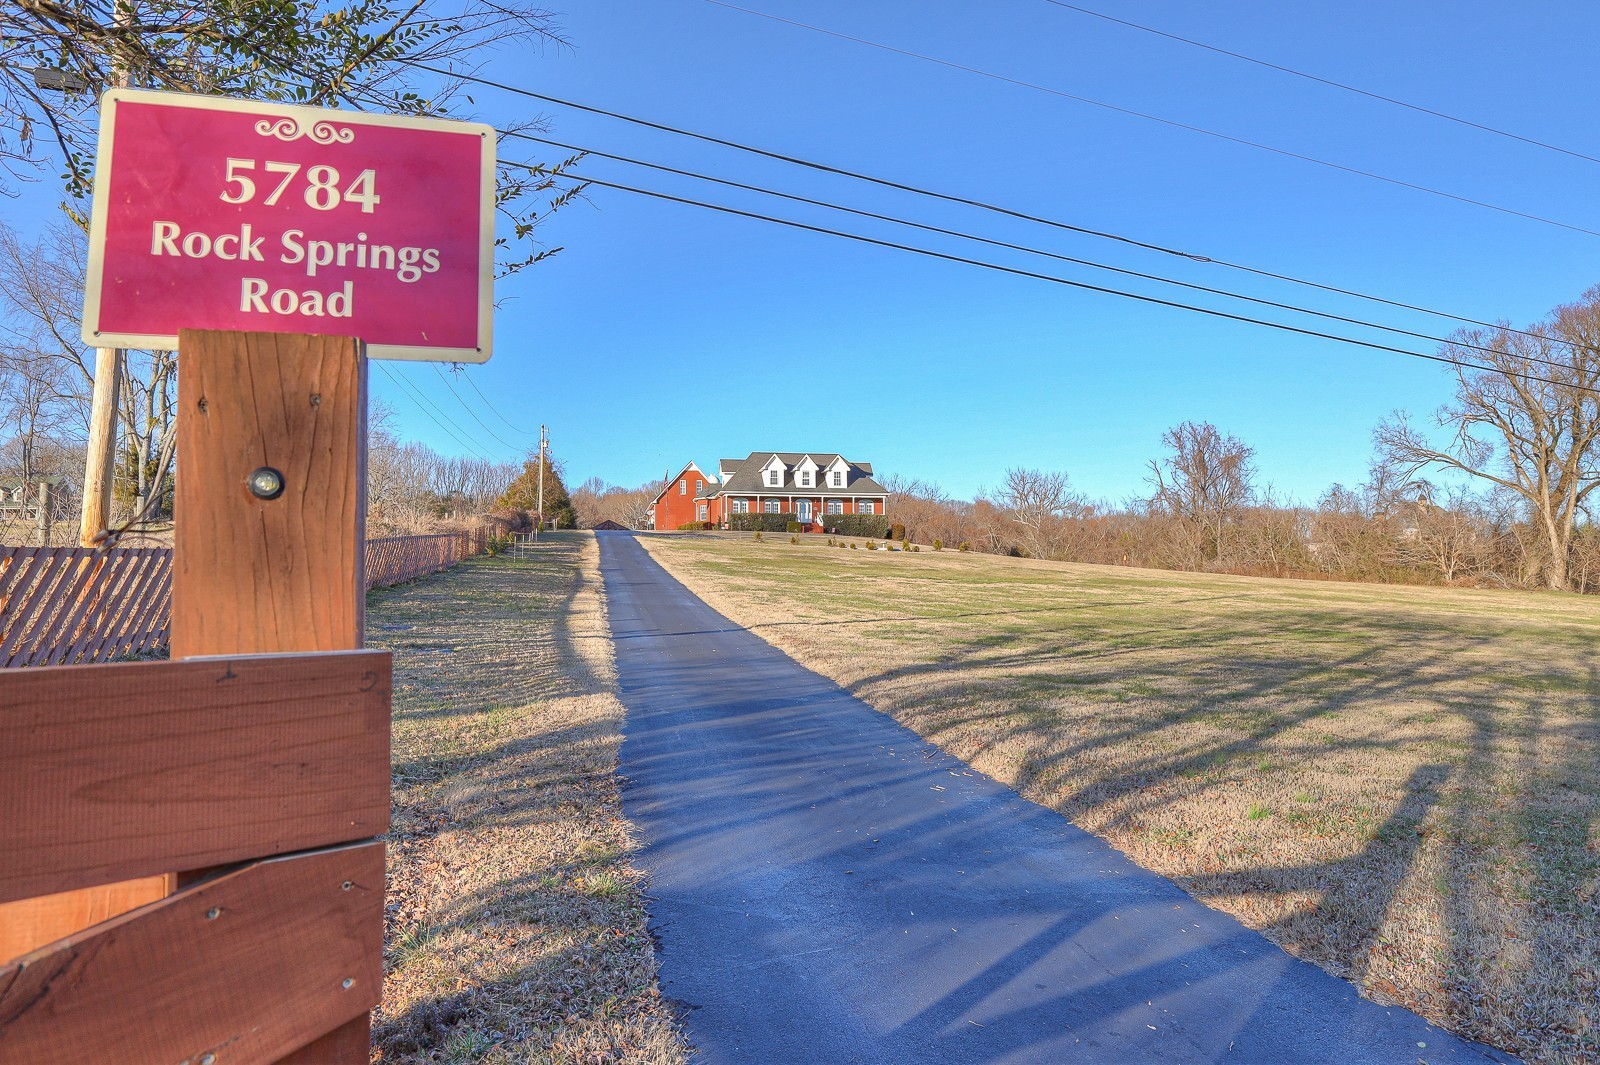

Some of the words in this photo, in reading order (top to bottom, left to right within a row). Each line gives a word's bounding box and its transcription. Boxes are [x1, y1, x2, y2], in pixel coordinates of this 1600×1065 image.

[219, 157, 381, 214] 5784
[150, 220, 266, 262] Rock
[279, 229, 441, 283] Springs
[239, 277, 354, 318] Road
